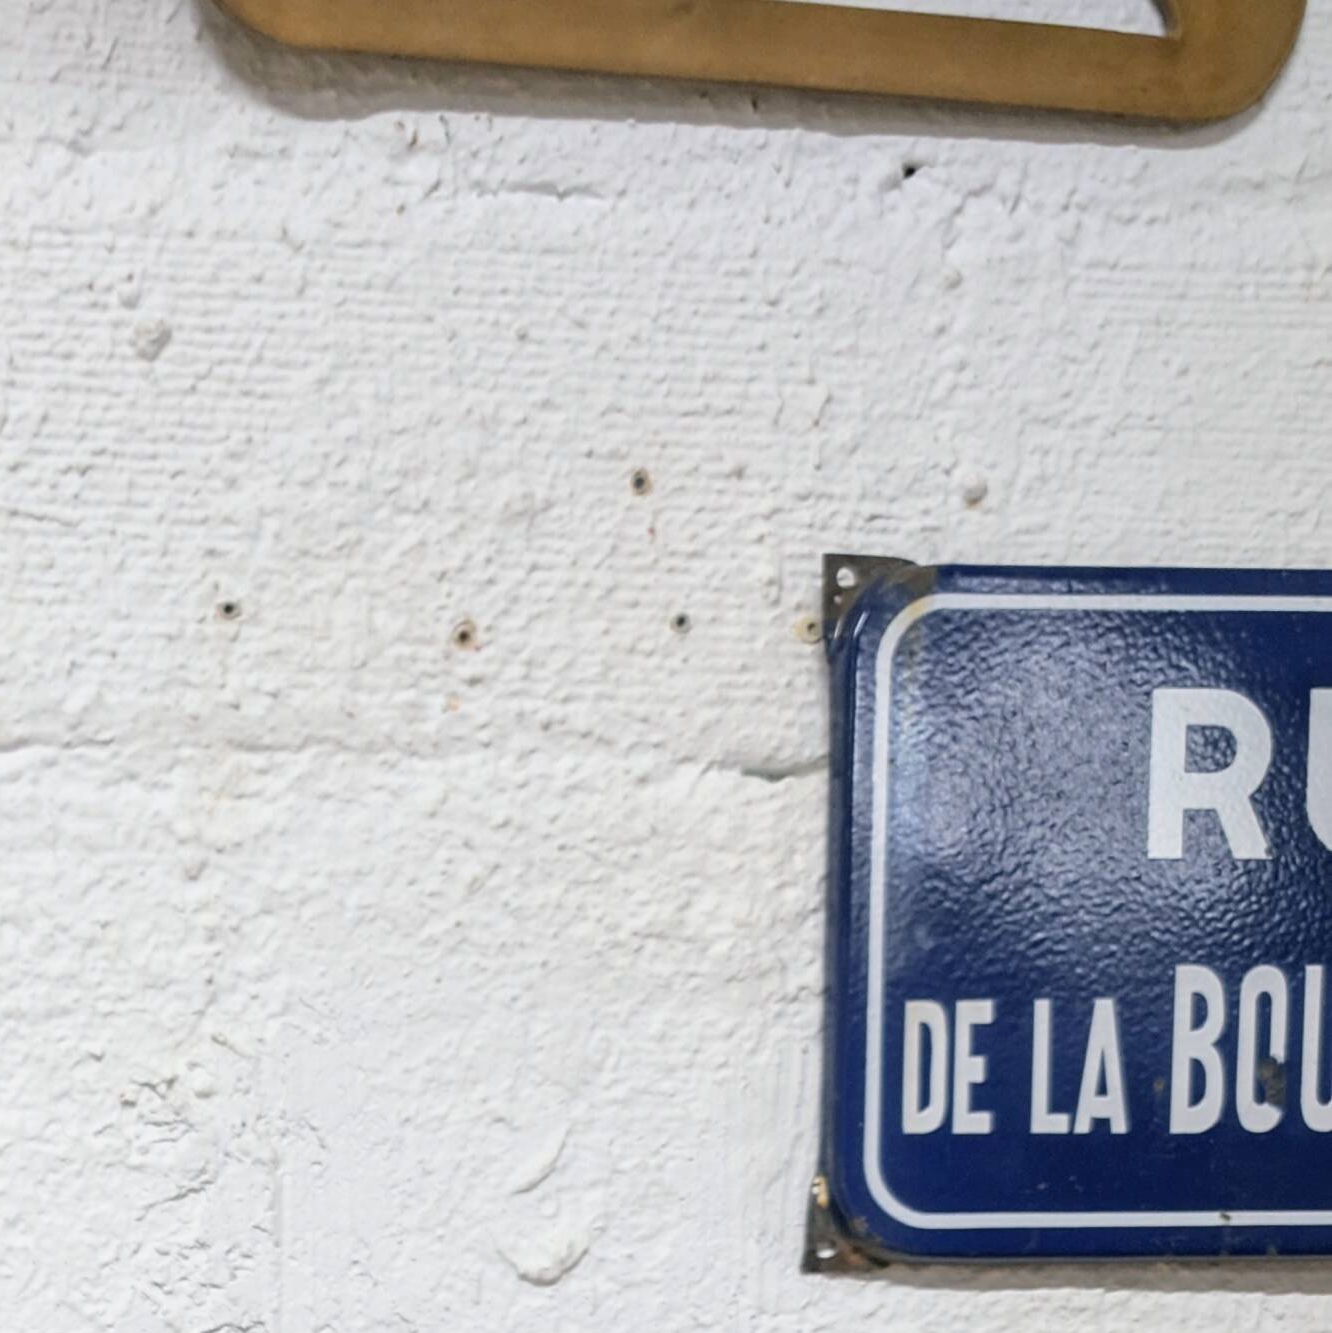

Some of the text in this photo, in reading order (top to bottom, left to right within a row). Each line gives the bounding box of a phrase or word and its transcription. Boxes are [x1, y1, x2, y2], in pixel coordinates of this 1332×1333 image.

[1146, 686, 1332, 861] R
[901, 999, 995, 1135] DE
[1030, 999, 1130, 1135] LA
